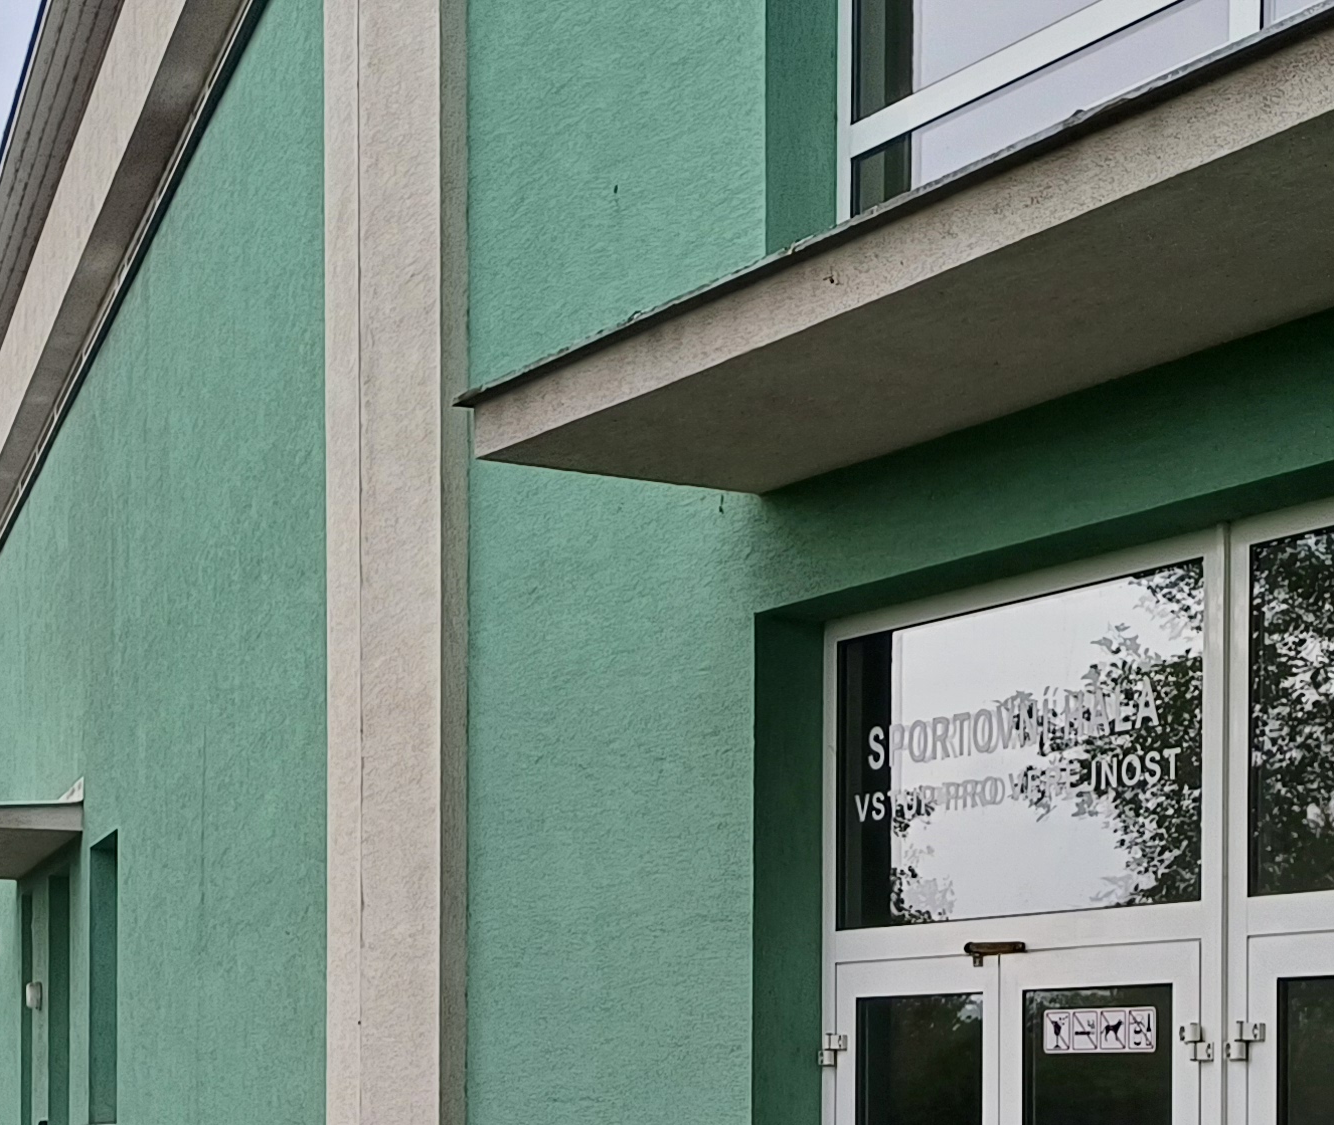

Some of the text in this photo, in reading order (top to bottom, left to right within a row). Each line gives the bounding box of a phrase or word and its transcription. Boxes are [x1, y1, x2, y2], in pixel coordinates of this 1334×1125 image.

[868, 687, 1053, 770] SPORTOVNÍ
[854, 785, 935, 822] VSTUP
[942, 776, 998, 811] PRO
